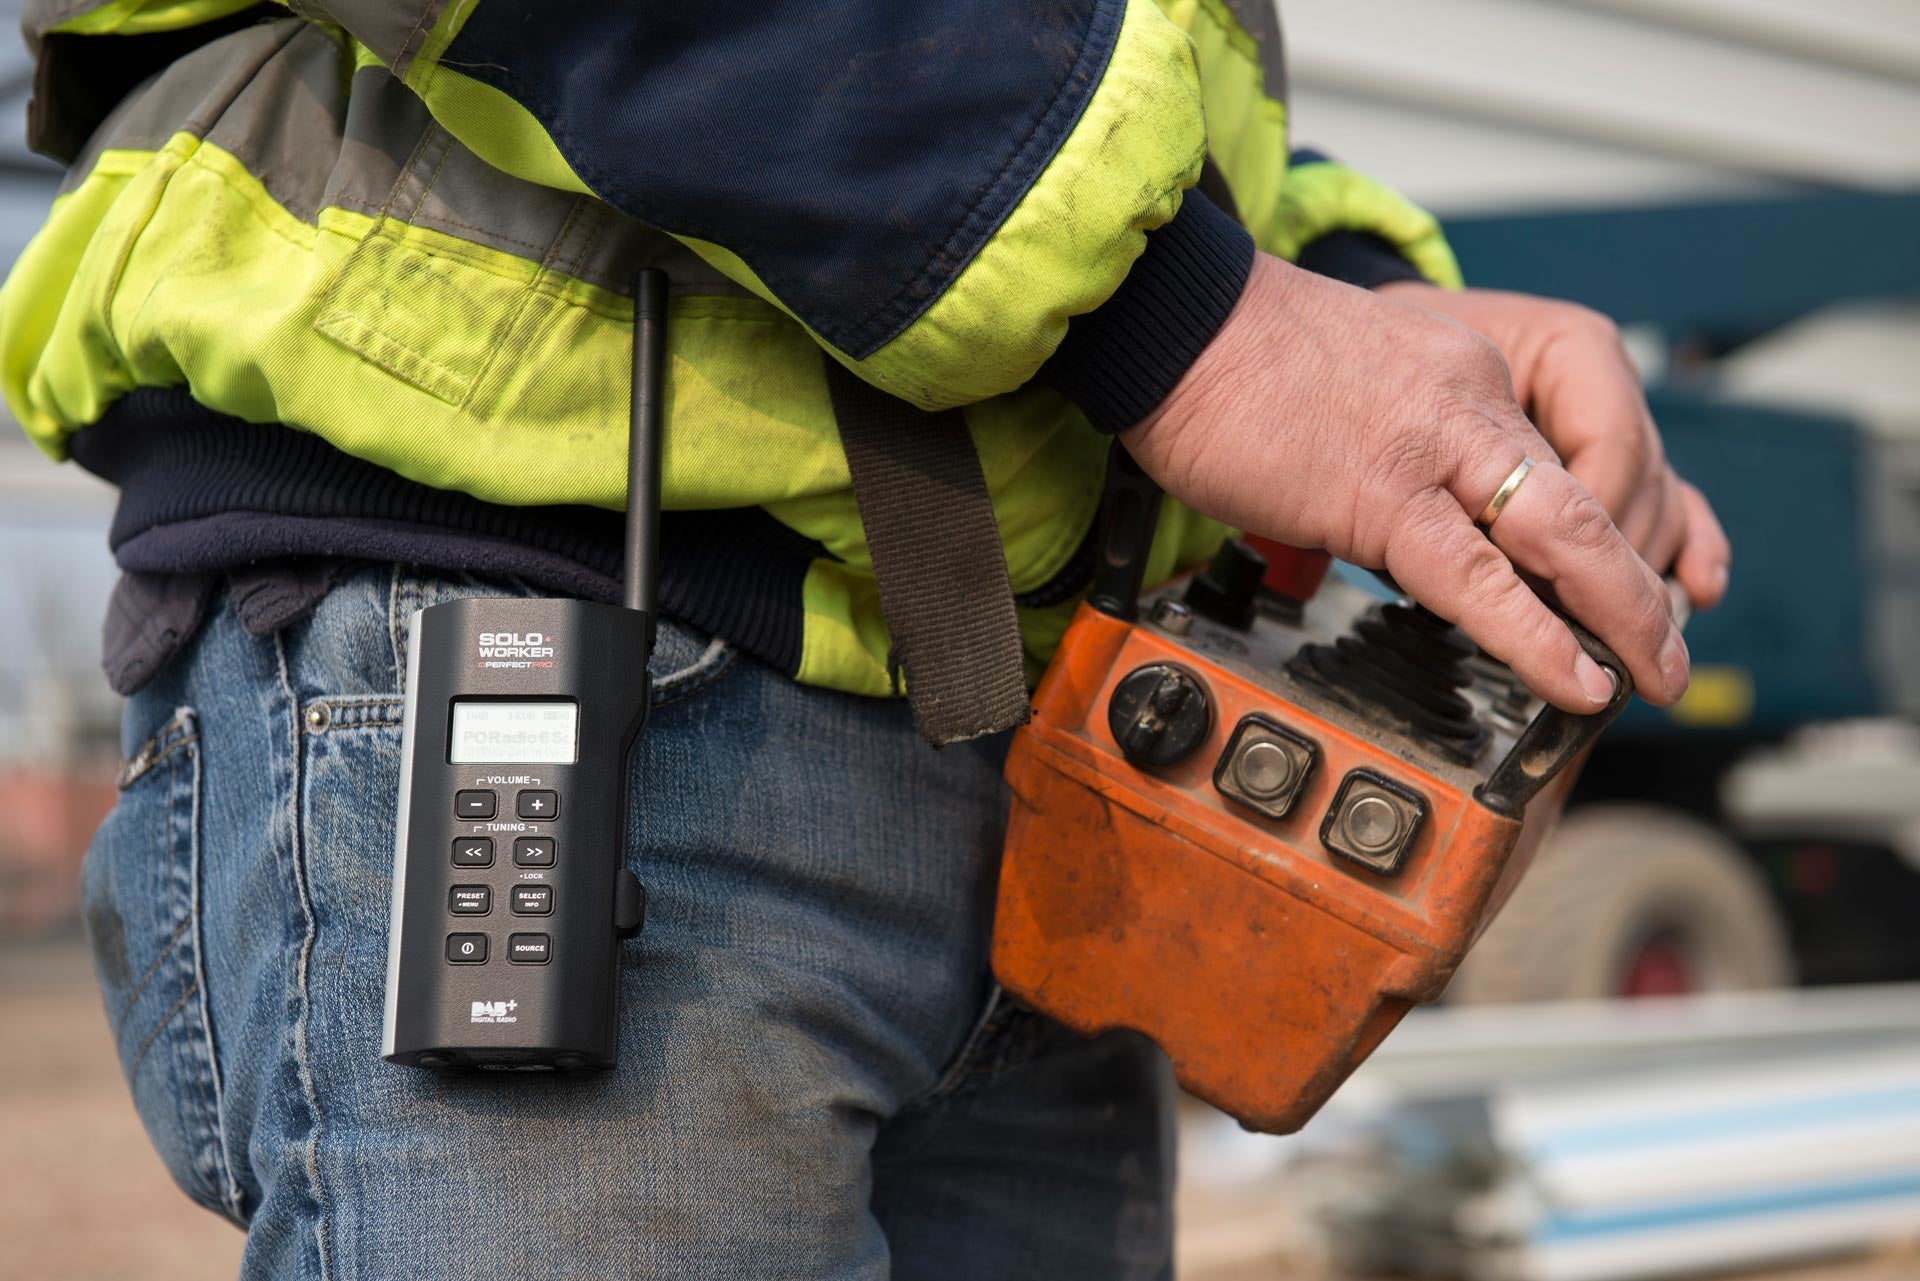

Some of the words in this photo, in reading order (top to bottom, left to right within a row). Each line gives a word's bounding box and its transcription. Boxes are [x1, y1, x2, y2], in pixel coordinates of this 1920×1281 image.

[479, 633, 543, 646] SOLO
[479, 647, 554, 658] WORKER
[487, 776, 530, 784] VOLUME
[486, 823, 526, 832] TUNING
